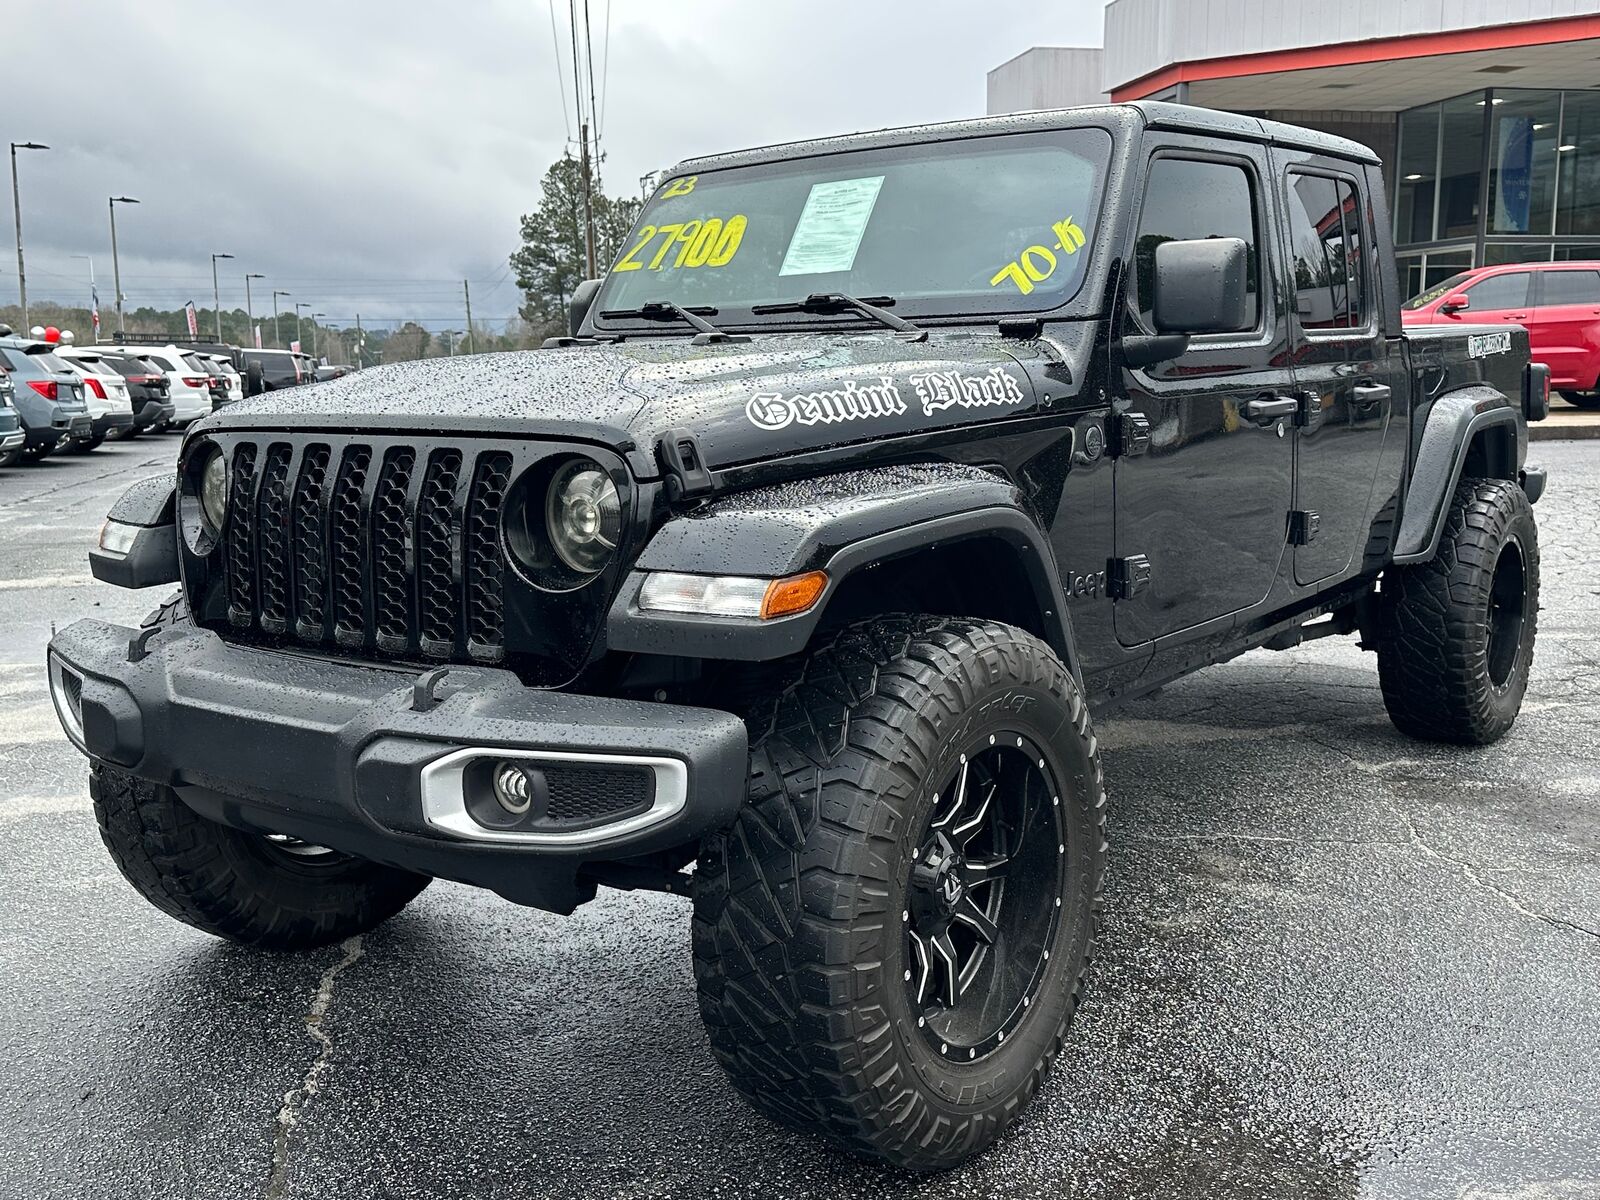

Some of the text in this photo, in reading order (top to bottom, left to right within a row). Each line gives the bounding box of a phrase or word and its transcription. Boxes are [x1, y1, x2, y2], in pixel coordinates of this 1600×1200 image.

[660, 176, 698, 199] 23
[612, 214, 748, 272] 27900
[745, 366, 1024, 430] Gemini Black
[1063, 570, 1105, 599] Jeep
